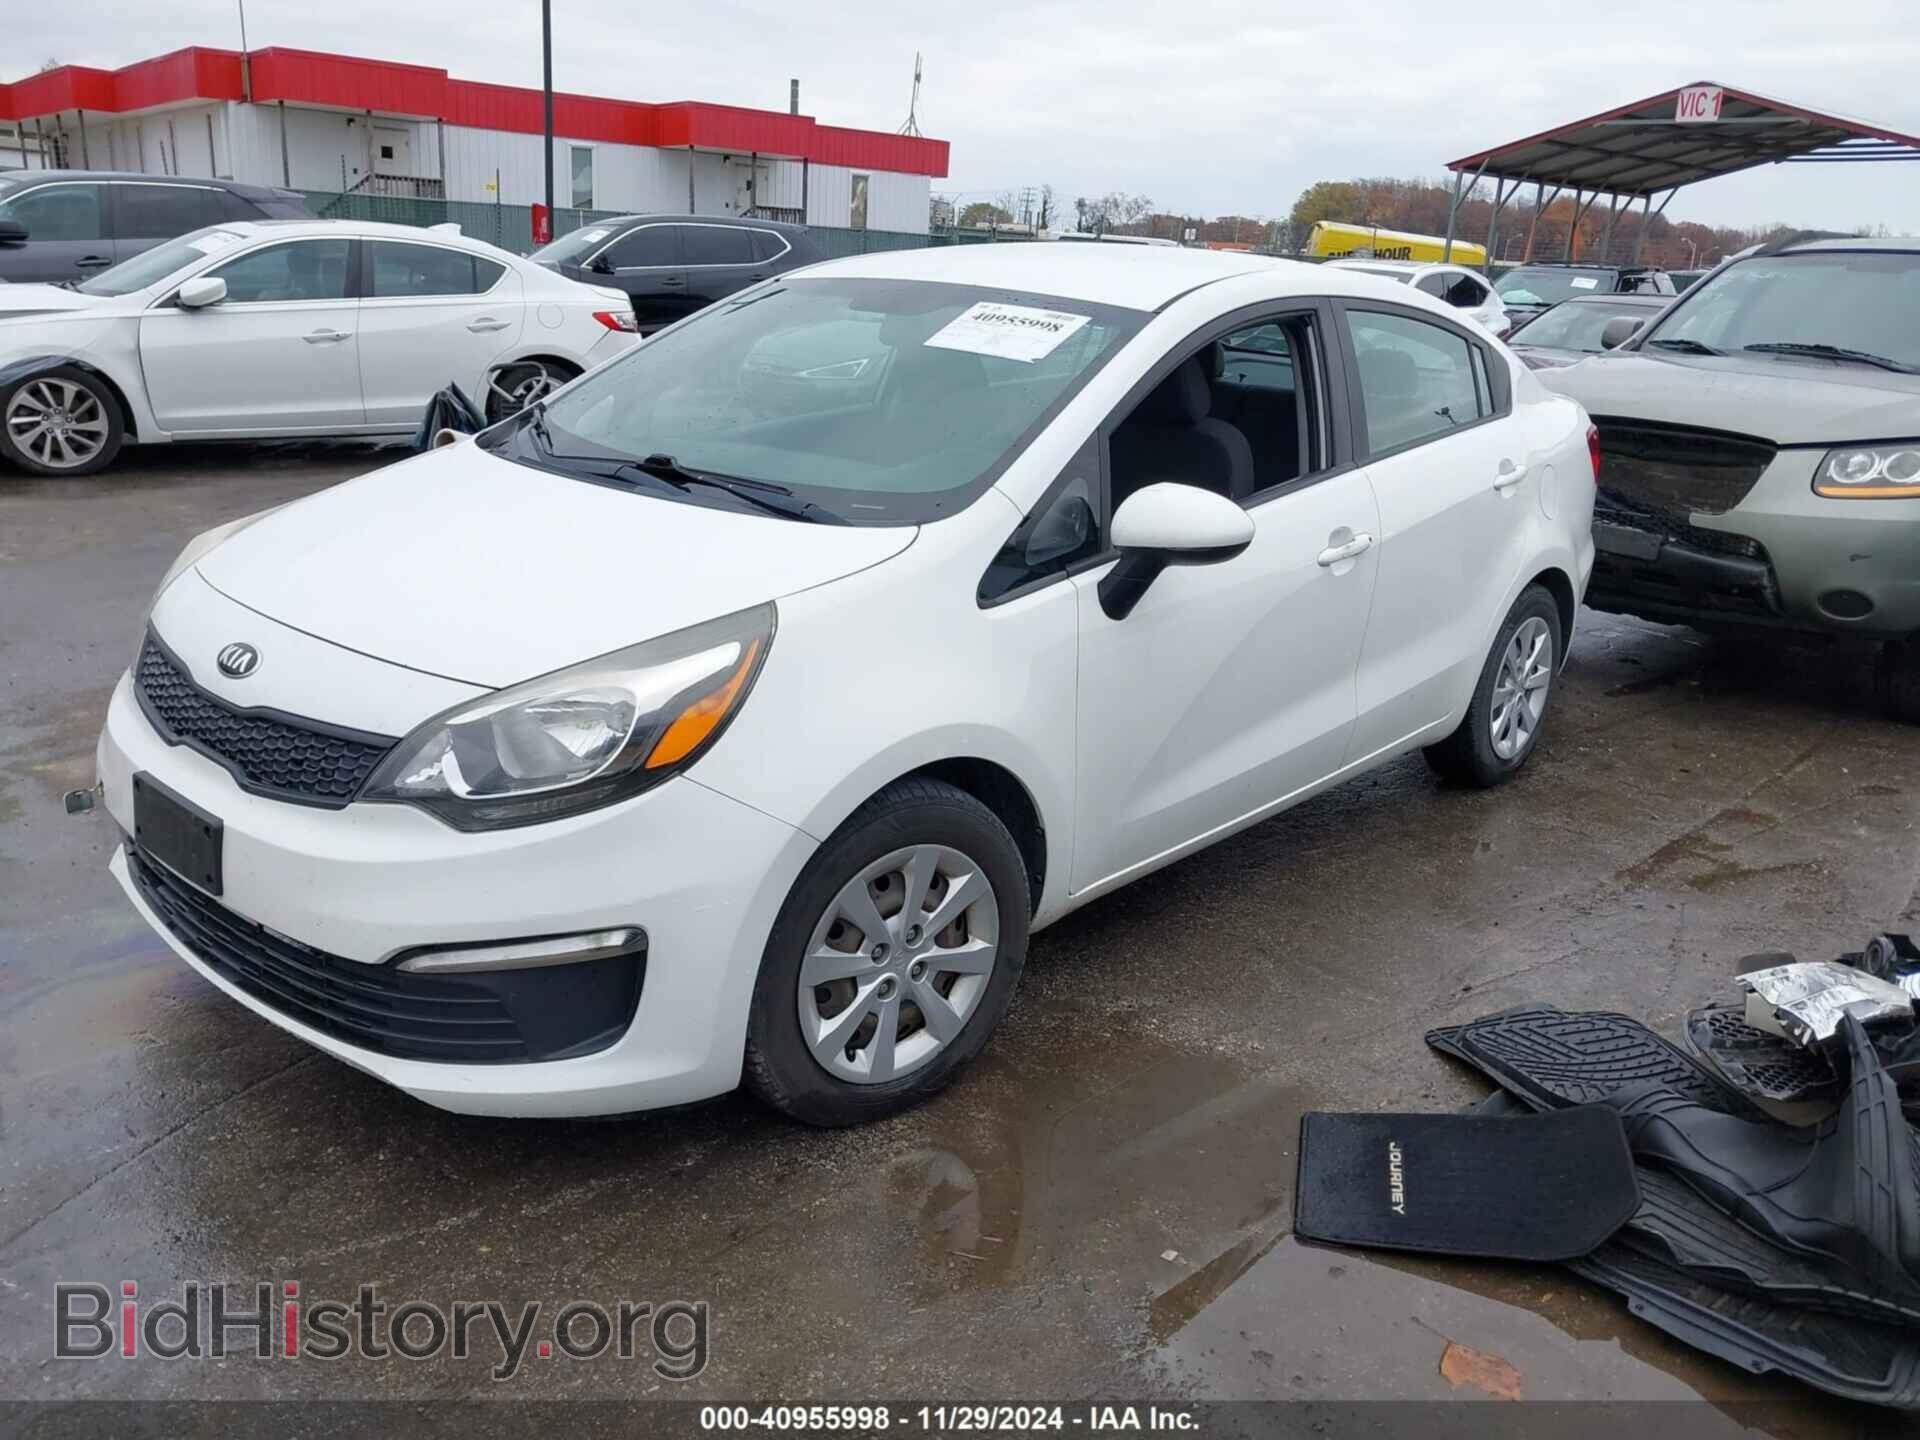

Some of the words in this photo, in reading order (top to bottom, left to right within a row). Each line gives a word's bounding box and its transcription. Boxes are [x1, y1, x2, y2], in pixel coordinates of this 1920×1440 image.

[1680, 91, 1707, 117] VIC
[1712, 91, 1721, 116] 1
[1374, 246, 1411, 260] HOUR
[973, 312, 1064, 332] 40955998
[219, 645, 253, 674] KIA
[1388, 1141, 1406, 1216] JOURNEY
